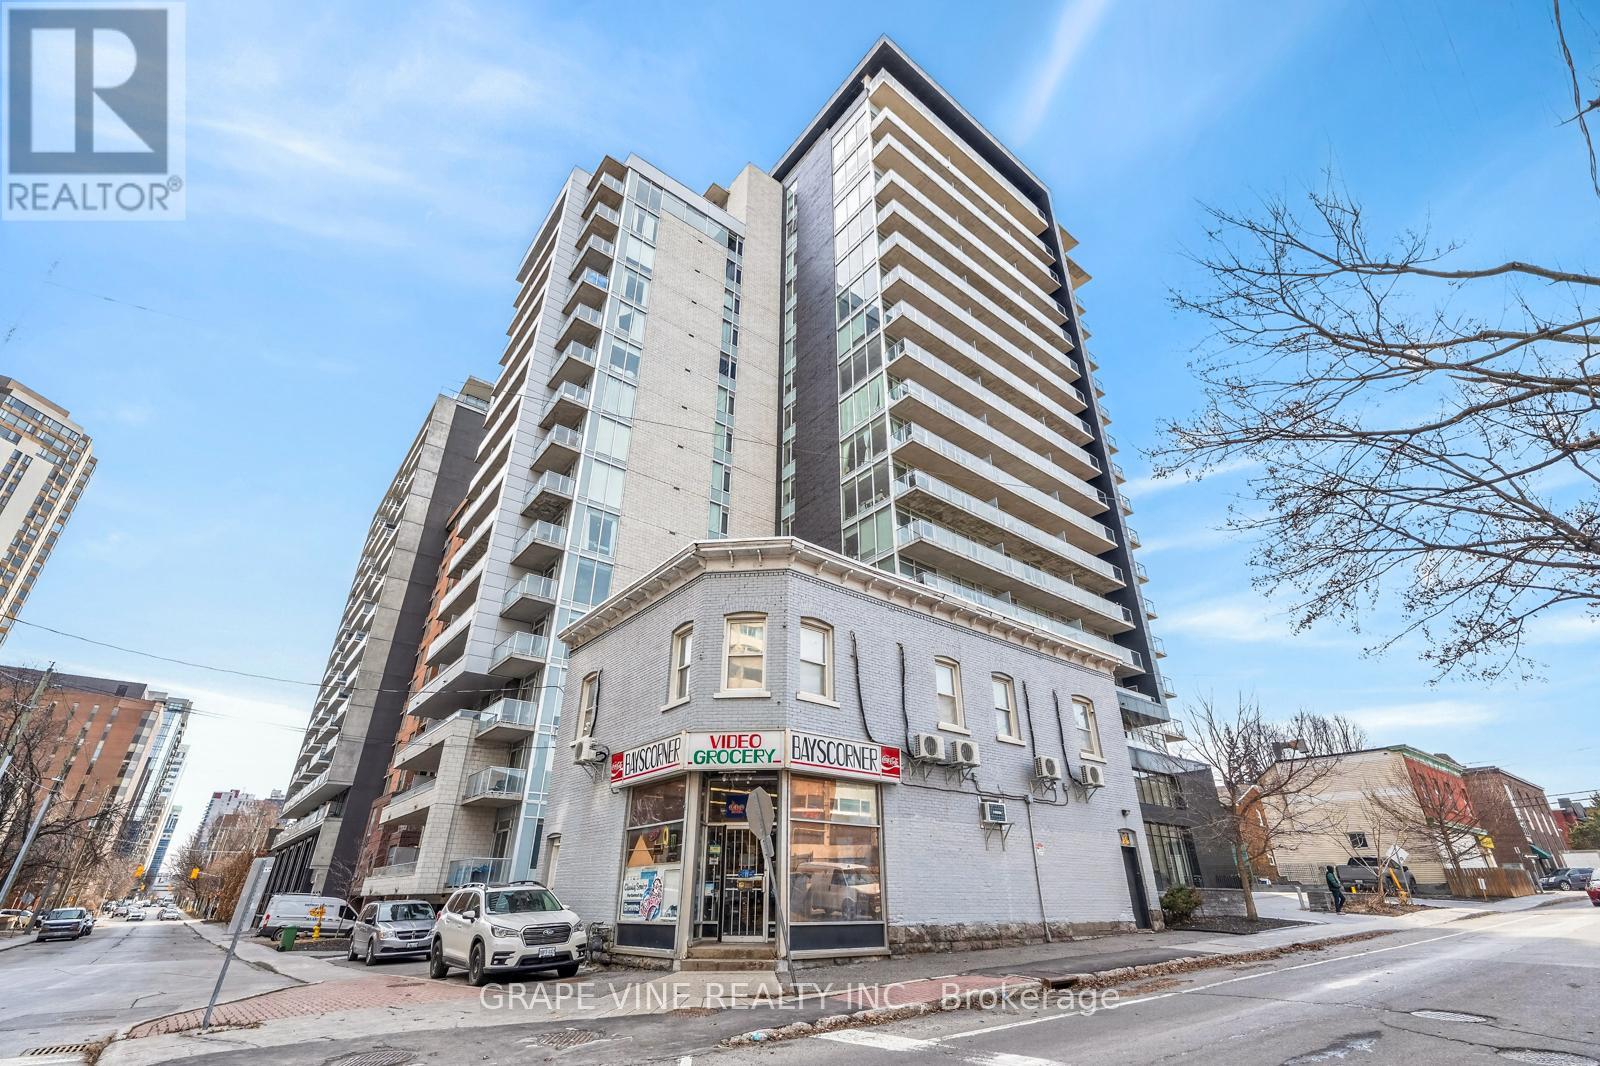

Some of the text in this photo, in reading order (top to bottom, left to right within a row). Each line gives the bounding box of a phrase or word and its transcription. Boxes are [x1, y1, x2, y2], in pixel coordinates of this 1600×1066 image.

[709, 733, 762, 749] VIDEO
[791, 735, 878, 772] BAYSCORNER
[624, 737, 681, 776] BAYSCORNER
[693, 749, 776, 764] GROCERY
